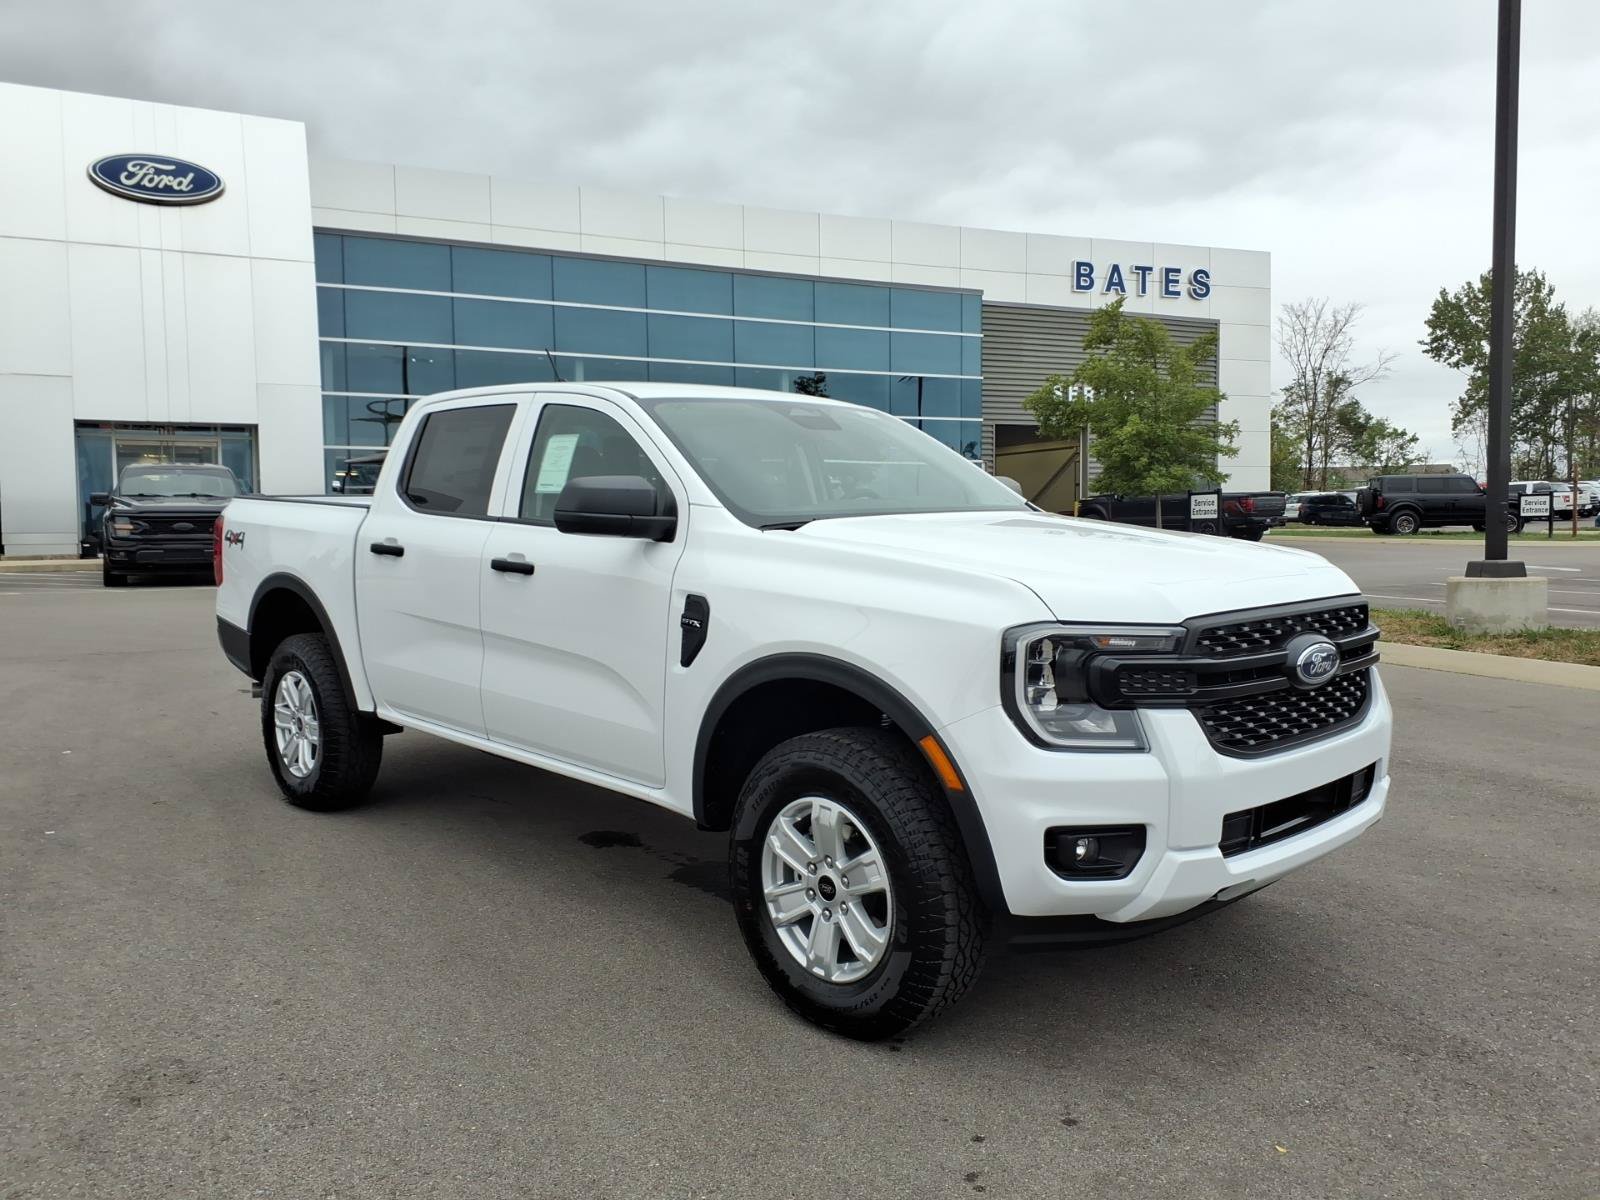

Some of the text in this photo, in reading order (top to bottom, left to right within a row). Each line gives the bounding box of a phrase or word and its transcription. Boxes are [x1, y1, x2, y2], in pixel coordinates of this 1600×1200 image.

[121, 161, 194, 192] Ford
[1075, 260, 1211, 299] BATES
[1310, 652, 1333, 675] Ford
